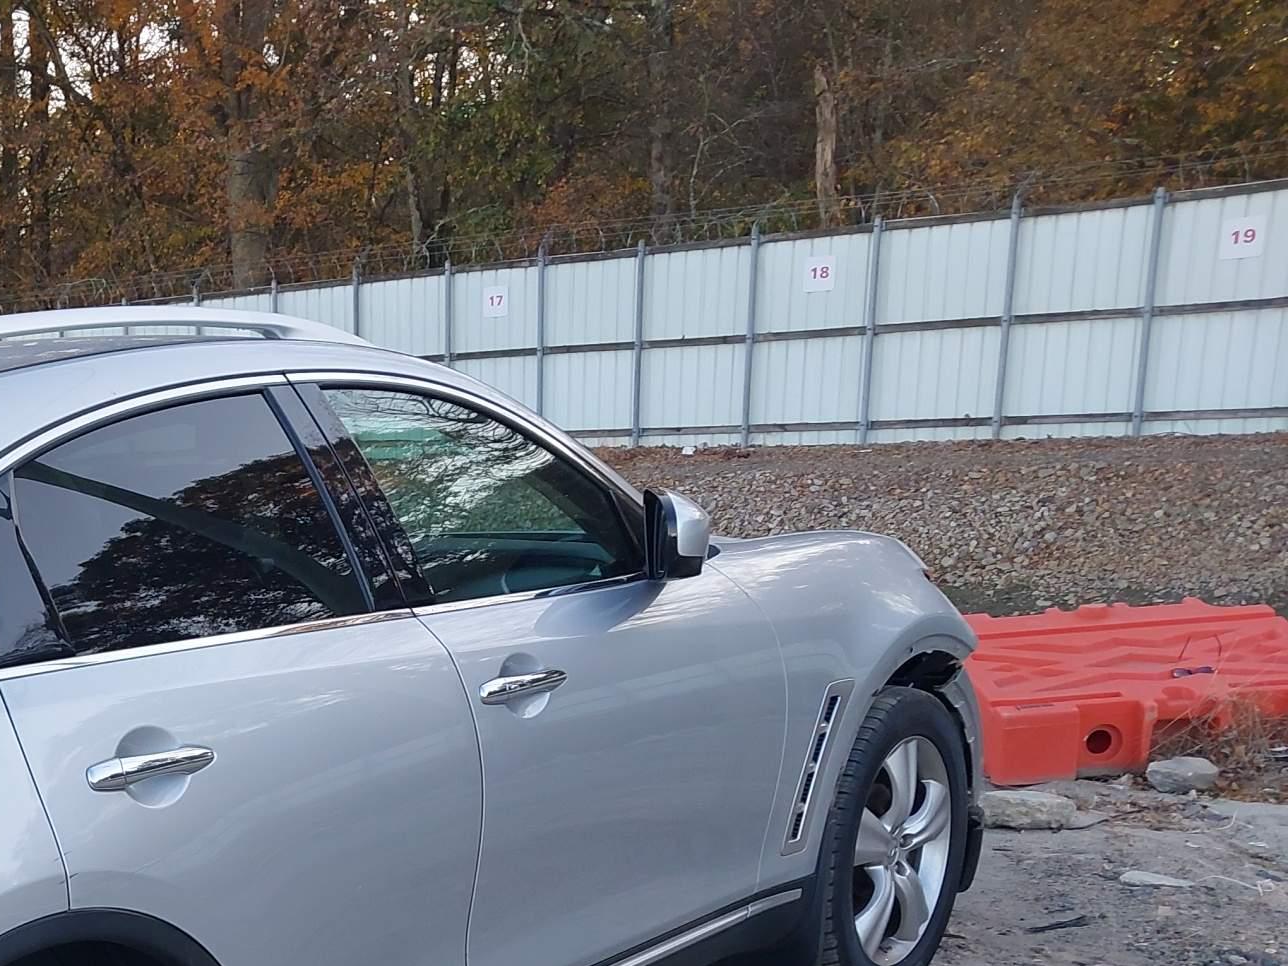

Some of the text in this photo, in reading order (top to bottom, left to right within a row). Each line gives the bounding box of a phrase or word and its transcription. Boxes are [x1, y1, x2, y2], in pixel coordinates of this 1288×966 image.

[1232, 229, 1256, 244] 19
[811, 266, 829, 279] 18
[489, 295, 503, 306] 17
